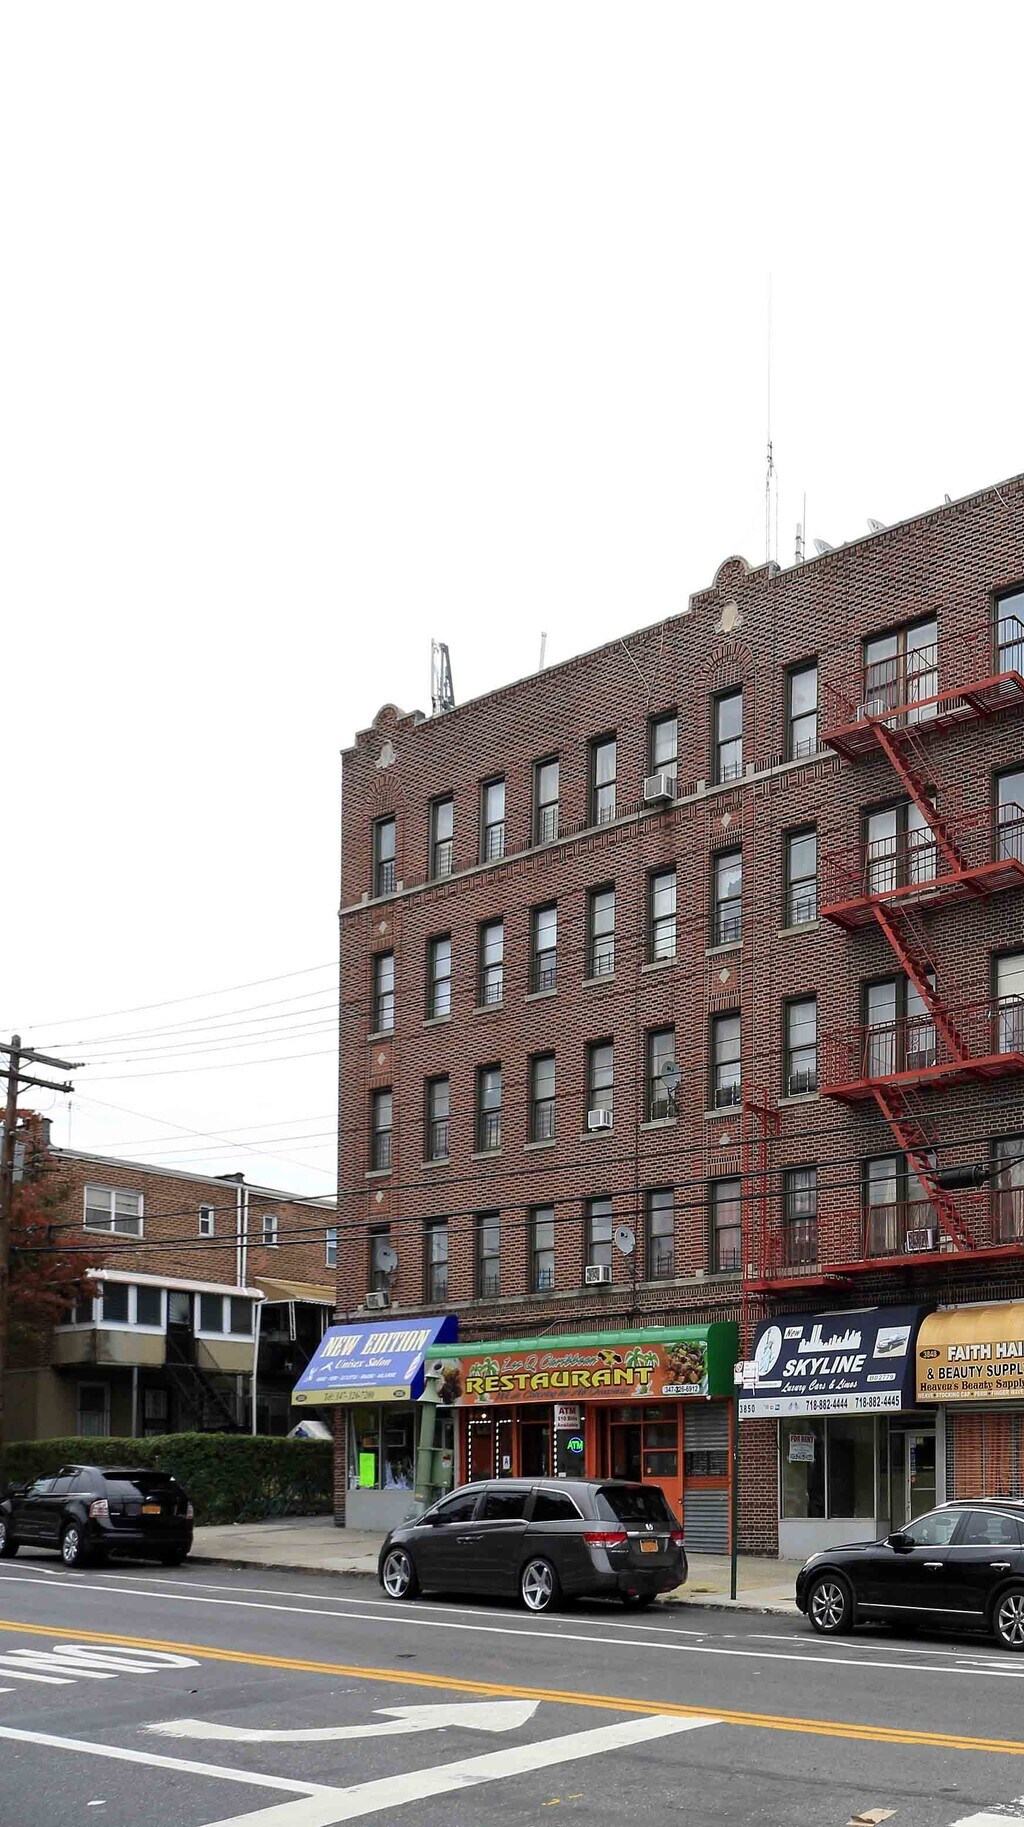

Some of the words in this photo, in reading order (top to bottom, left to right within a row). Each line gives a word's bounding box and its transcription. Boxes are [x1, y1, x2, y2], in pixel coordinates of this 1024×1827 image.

[786, 1329, 801, 1338] New
[320, 1334, 363, 1358] NEW
[360, 1329, 432, 1355] EDITION
[947, 1343, 992, 1362] FAITH
[365, 1357, 392, 1368] Salon
[782, 1354, 867, 1377] SKYLINE
[938, 1365, 983, 1380] BEAUTY
[465, 1366, 653, 1394] RESTAURANT
[781, 1382, 807, 1395] Luxury
[808, 1379, 826, 1391] Cars
[835, 1378, 858, 1390] Limos
[920, 1381, 959, 1391] Heaven's
[961, 1379, 993, 1392] Beauty
[805, 1398, 848, 1411] 718-882-4444
[855, 1395, 900, 1408] 718-882-4445
[558, 1407, 576, 1415] ATM
[739, 1404, 756, 1414] 3850
[567, 1440, 583, 1450] ATM
[790, 1435, 800, 1443] FOR
